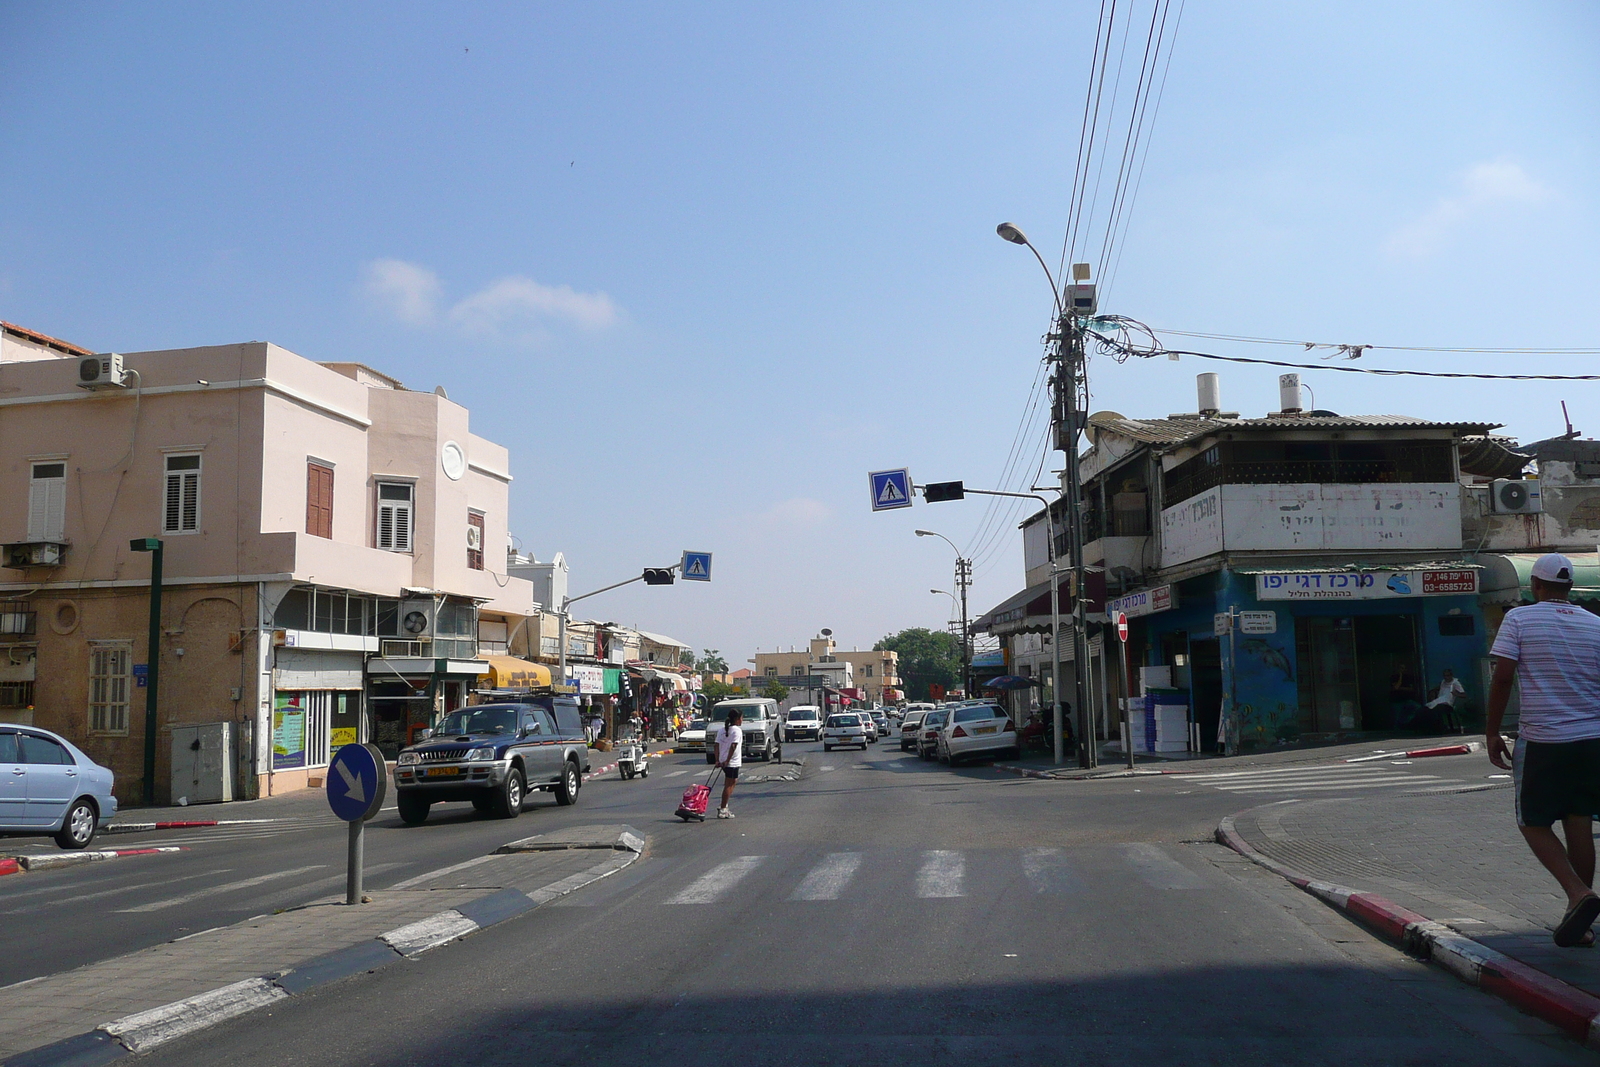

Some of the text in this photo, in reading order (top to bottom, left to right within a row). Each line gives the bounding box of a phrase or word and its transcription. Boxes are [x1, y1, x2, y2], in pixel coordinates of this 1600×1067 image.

[1263, 574, 1374, 589] מרכז דגי יפו
[1424, 582, 1473, 591] 03-6585723
[1288, 590, 1310, 598] חליל
